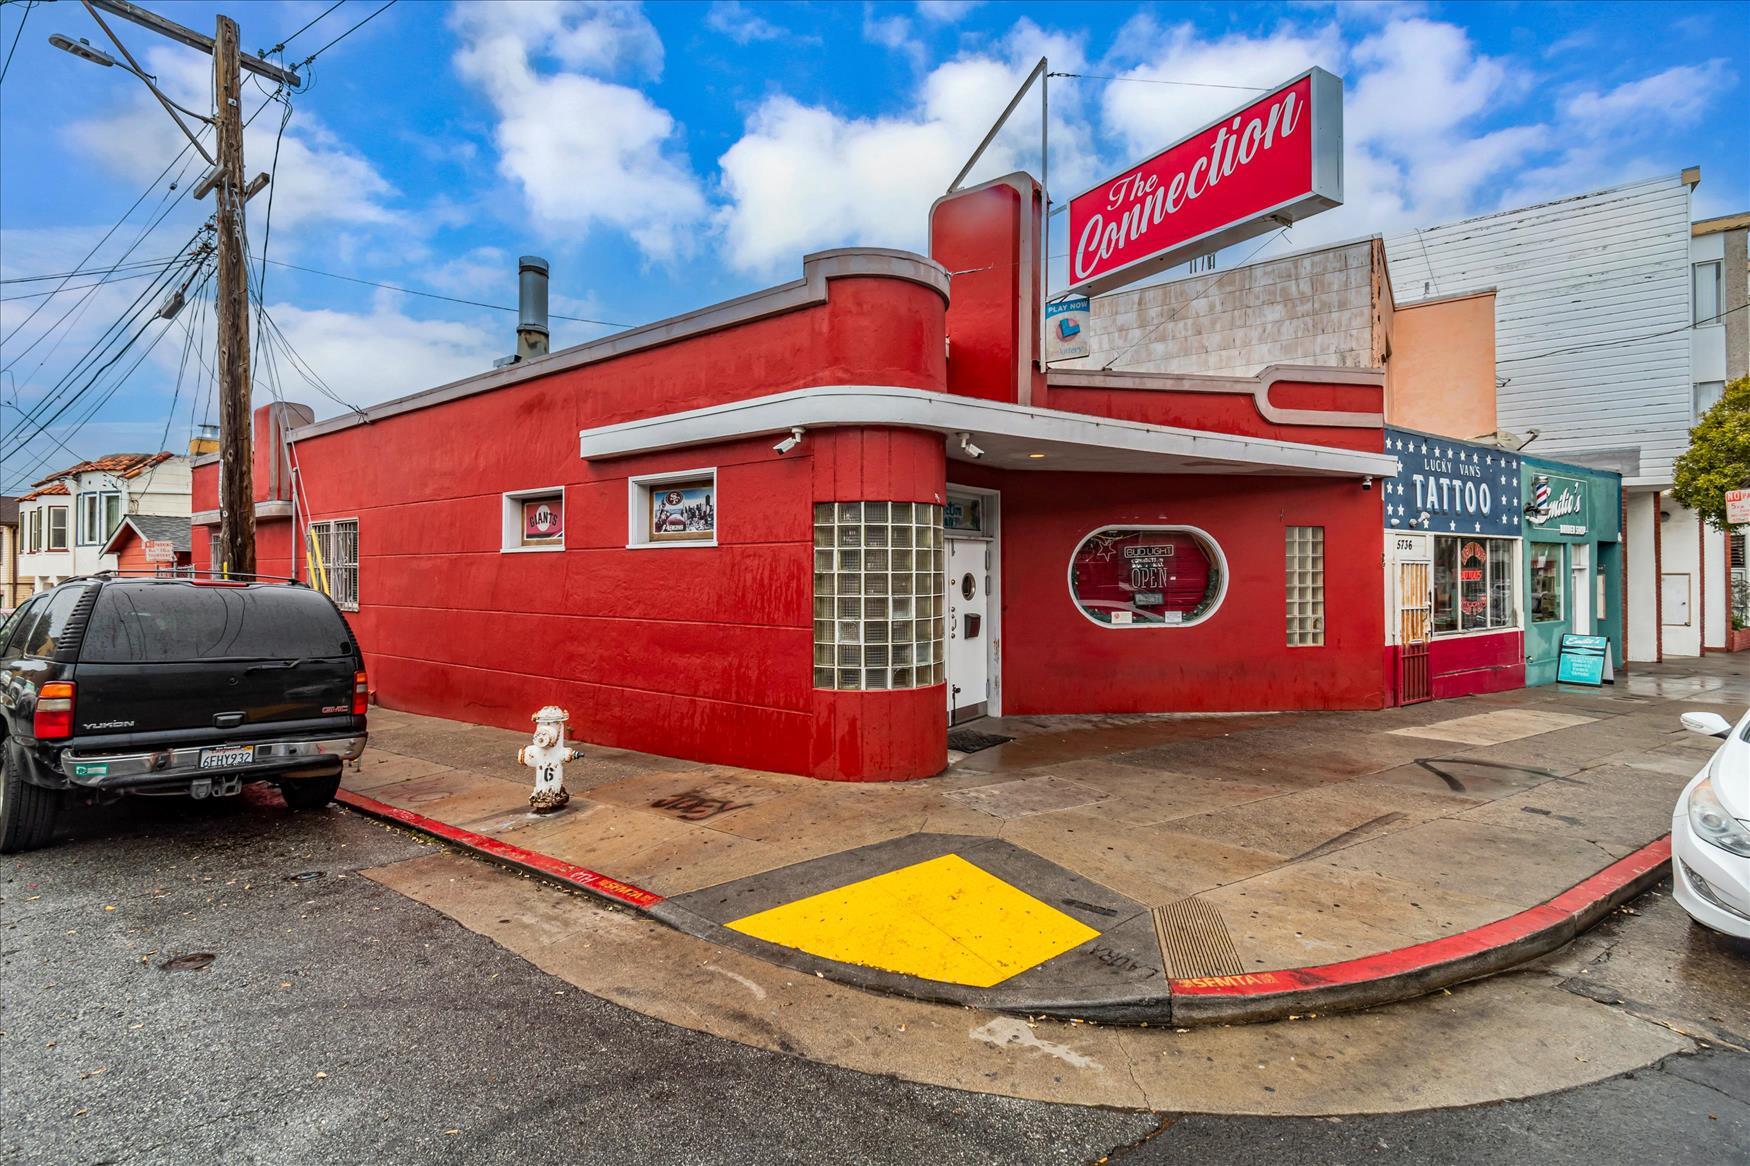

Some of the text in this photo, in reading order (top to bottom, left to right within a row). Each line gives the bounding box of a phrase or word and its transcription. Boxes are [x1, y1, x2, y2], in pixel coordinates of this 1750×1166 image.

[1075, 91, 1304, 279] Connection
[1107, 174, 1158, 211] The
[1048, 300, 1088, 313] PLAY NOW
[1424, 458, 1481, 478] LUCKY VAN'S
[1412, 474, 1491, 517] TATTOO
[529, 511, 558, 528] GIANTS
[1126, 547, 1172, 557] BUD LIGHT
[1396, 539, 1413, 551] 5736
[1131, 567, 1168, 589] OPEN
[321, 705, 349, 714] GMC
[83, 720, 135, 730] YUKON
[202, 752, 251, 768] 6FHY932
